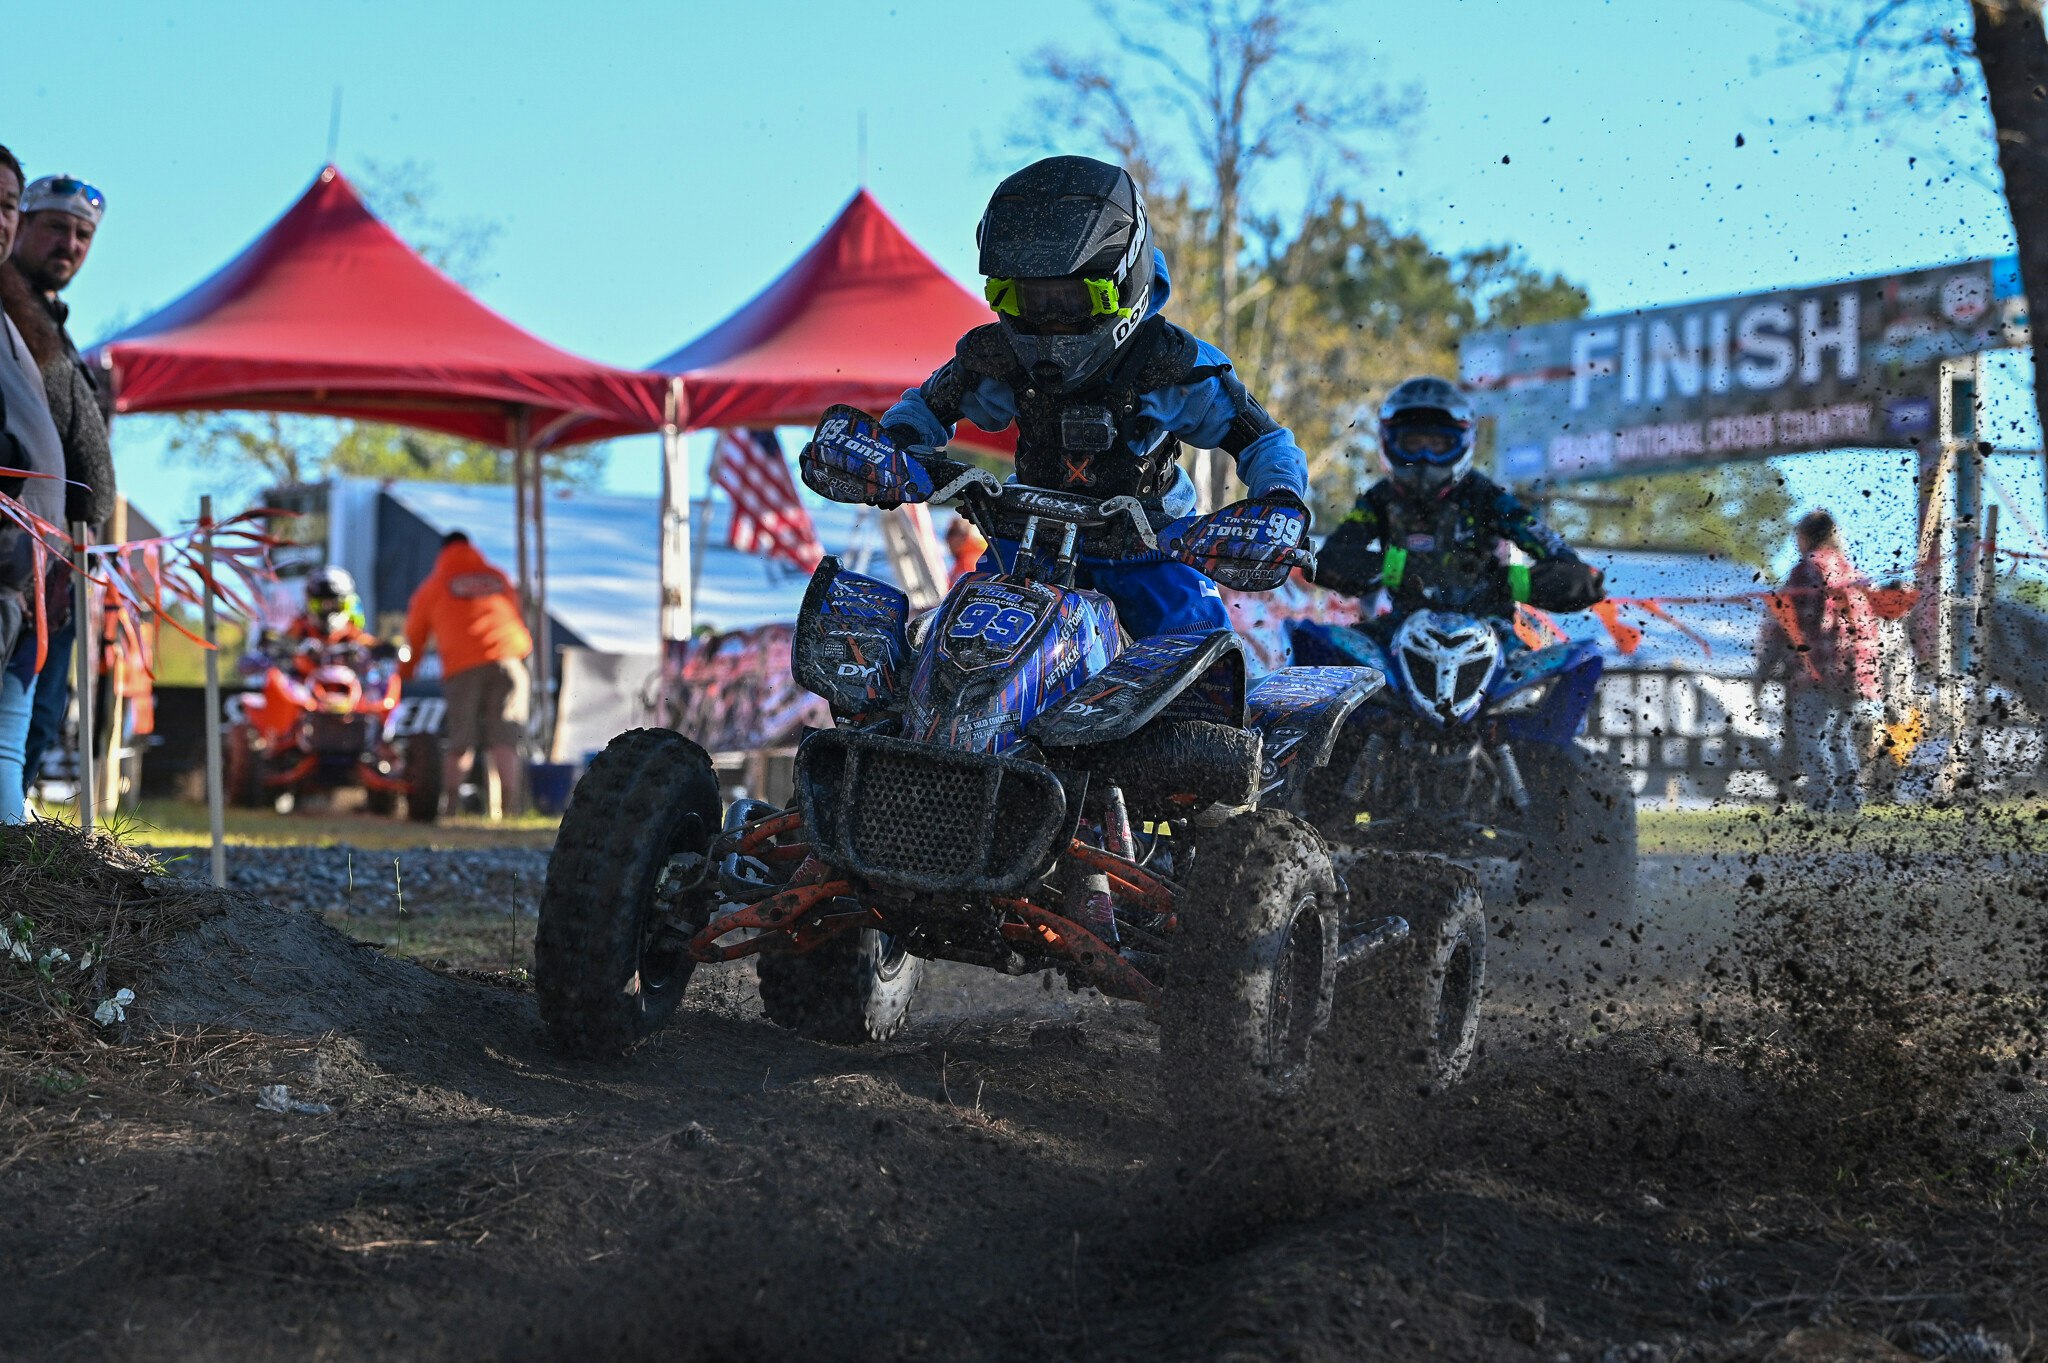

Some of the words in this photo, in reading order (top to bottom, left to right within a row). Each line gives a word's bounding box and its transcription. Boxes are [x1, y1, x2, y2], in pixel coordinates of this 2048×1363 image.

[1570, 291, 1861, 411] FINISH
[1206, 523, 1259, 540] Tony
[1265, 512, 1301, 547] 99
[947, 602, 1037, 645] 99
[1044, 645, 1079, 689] HETRICK
